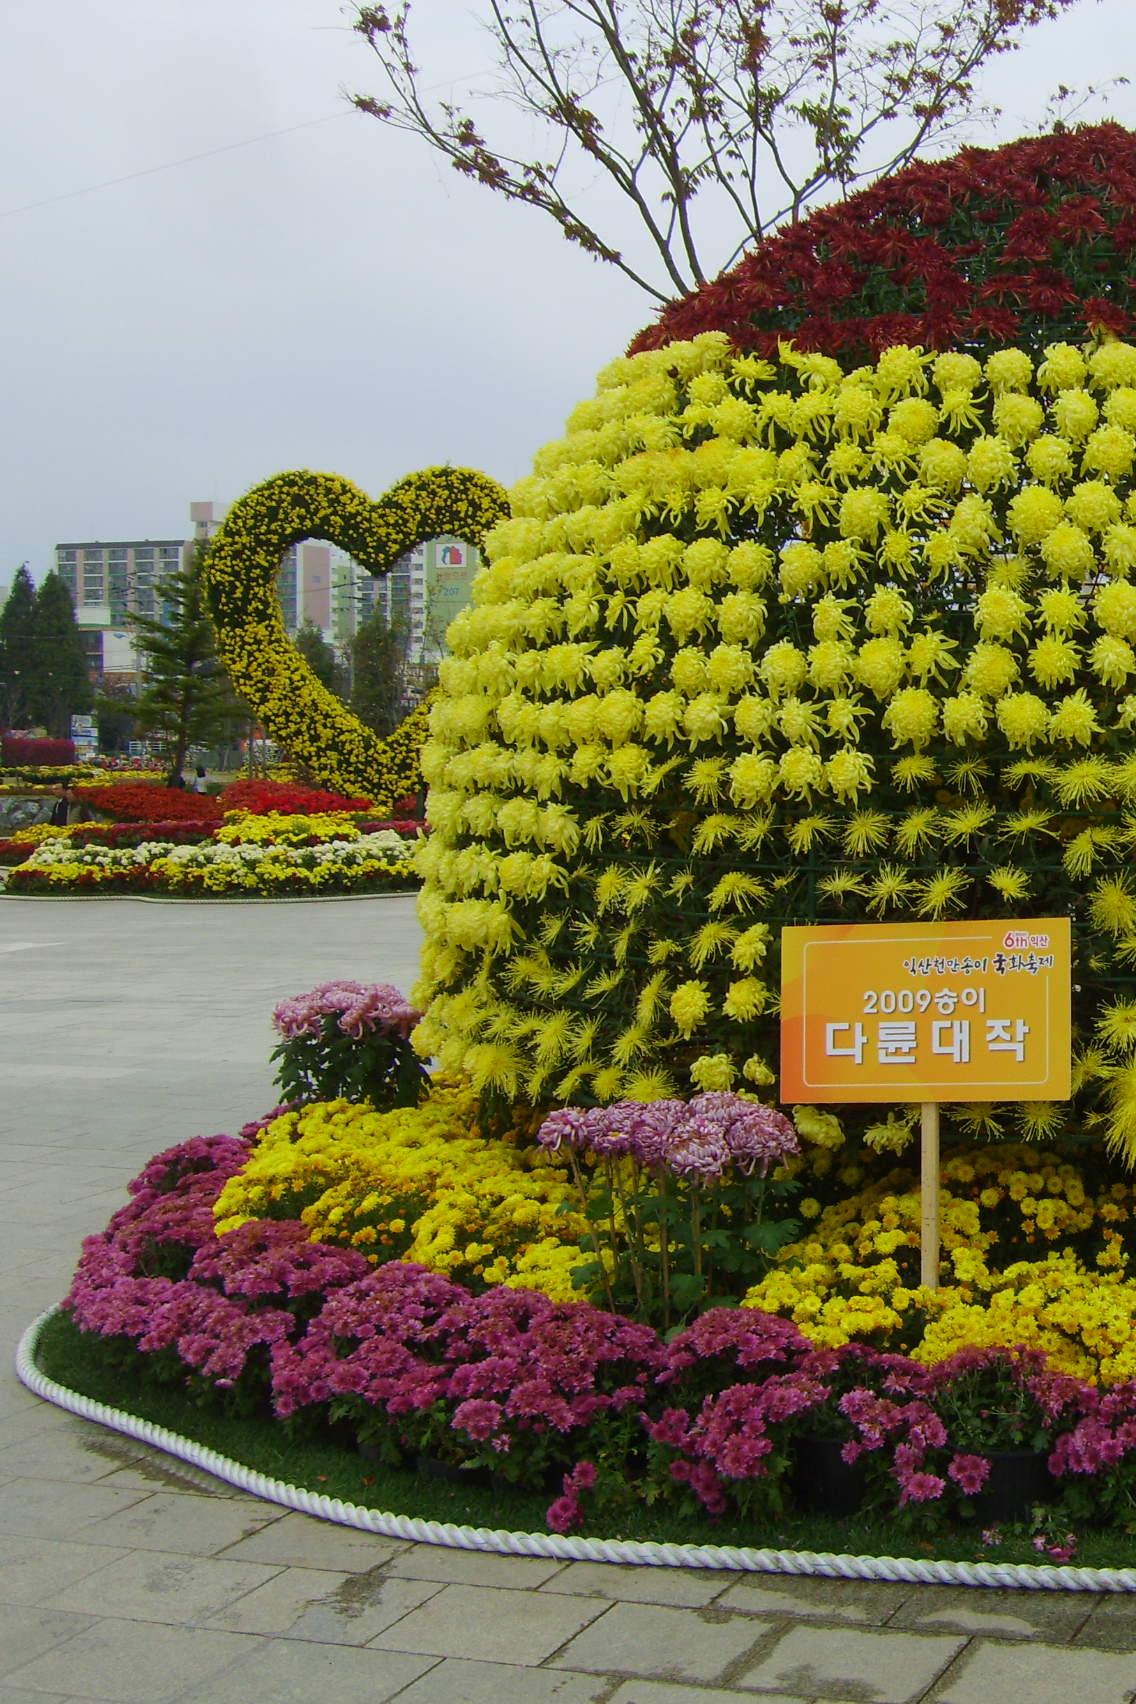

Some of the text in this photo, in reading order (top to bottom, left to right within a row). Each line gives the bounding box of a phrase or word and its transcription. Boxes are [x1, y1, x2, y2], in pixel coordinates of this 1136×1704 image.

[1004, 932, 1048, 948] 6th 익산
[992, 952, 1054, 975] 국화축제
[863, 987, 986, 1014] 2009송이
[825, 1019, 1030, 1065] 다륜대작
